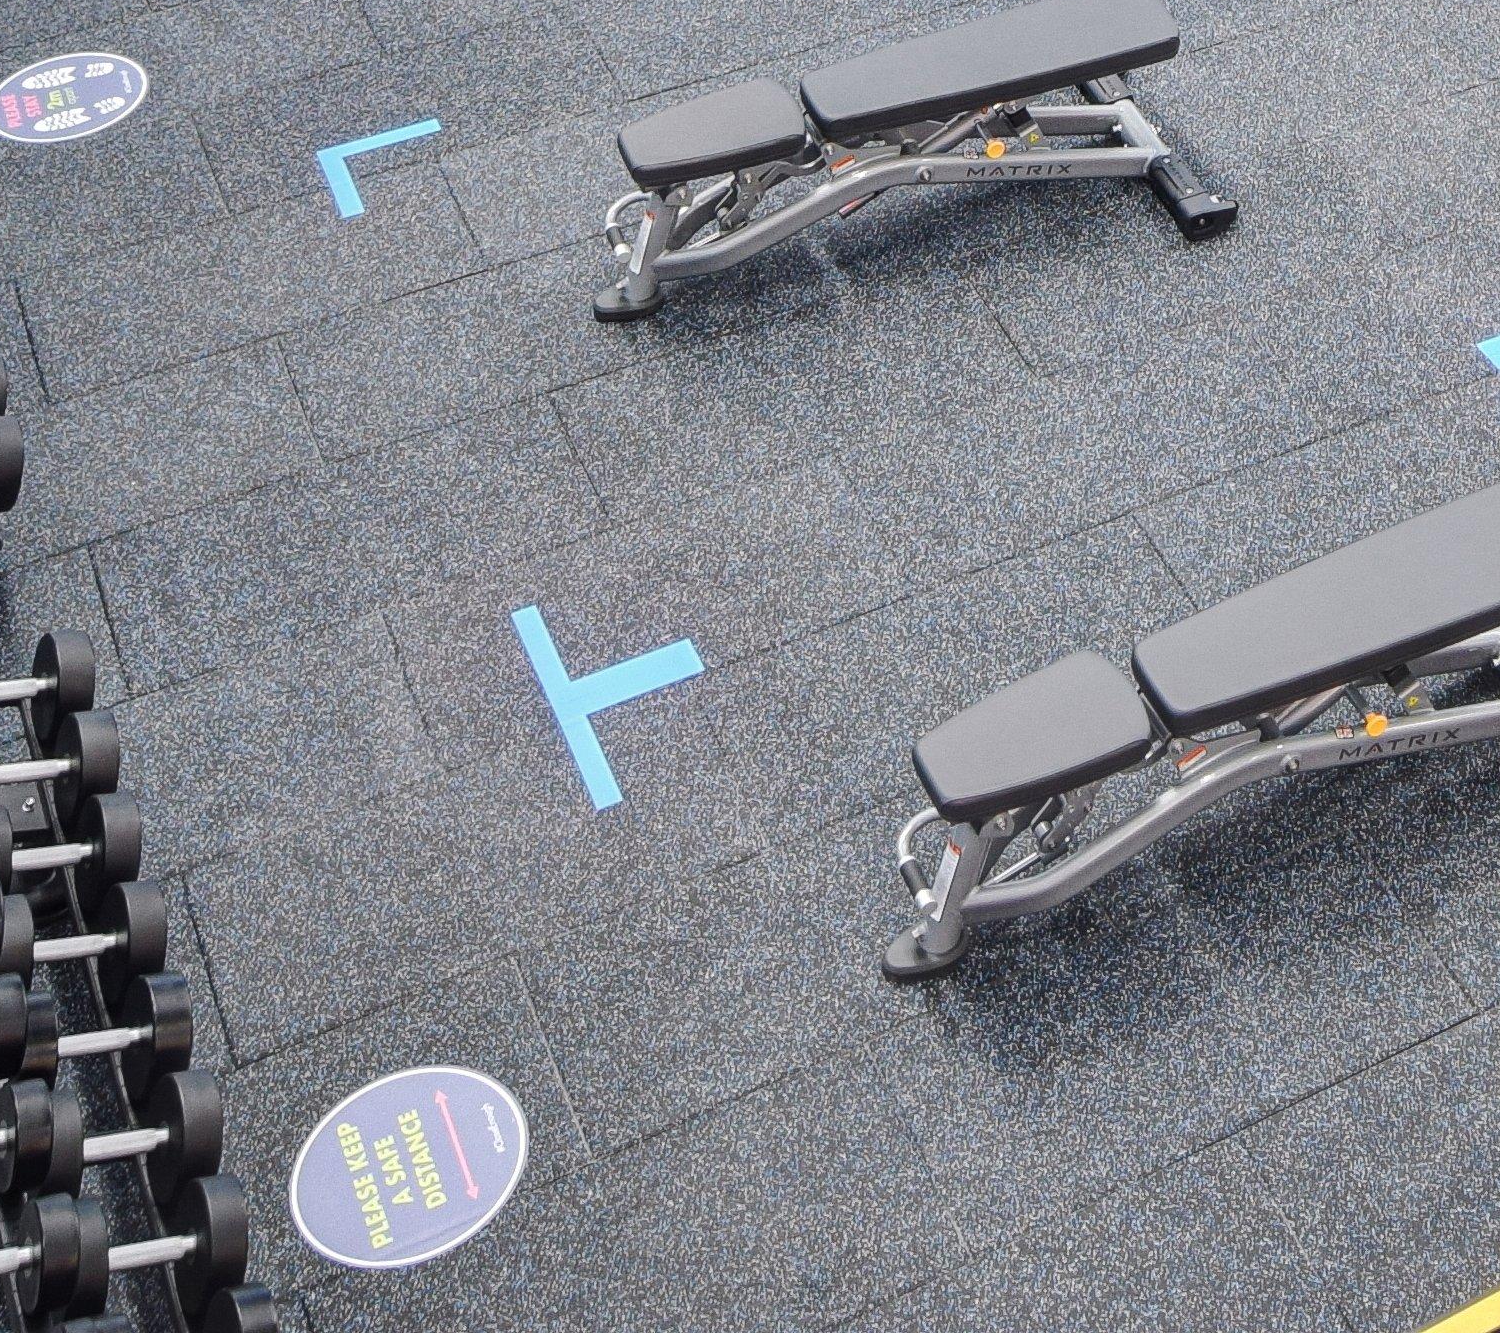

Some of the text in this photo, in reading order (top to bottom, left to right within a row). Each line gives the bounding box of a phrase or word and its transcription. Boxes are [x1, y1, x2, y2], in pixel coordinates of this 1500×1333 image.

[23, 94, 42, 118] STAY
[967, 163, 1073, 178] MATRIX
[1339, 728, 1460, 760] MATRIX
[373, 1134, 414, 1206] A SAFE
[397, 1108, 448, 1210] DISTANCE
[337, 1122, 394, 1250] PLEASE KEEP
